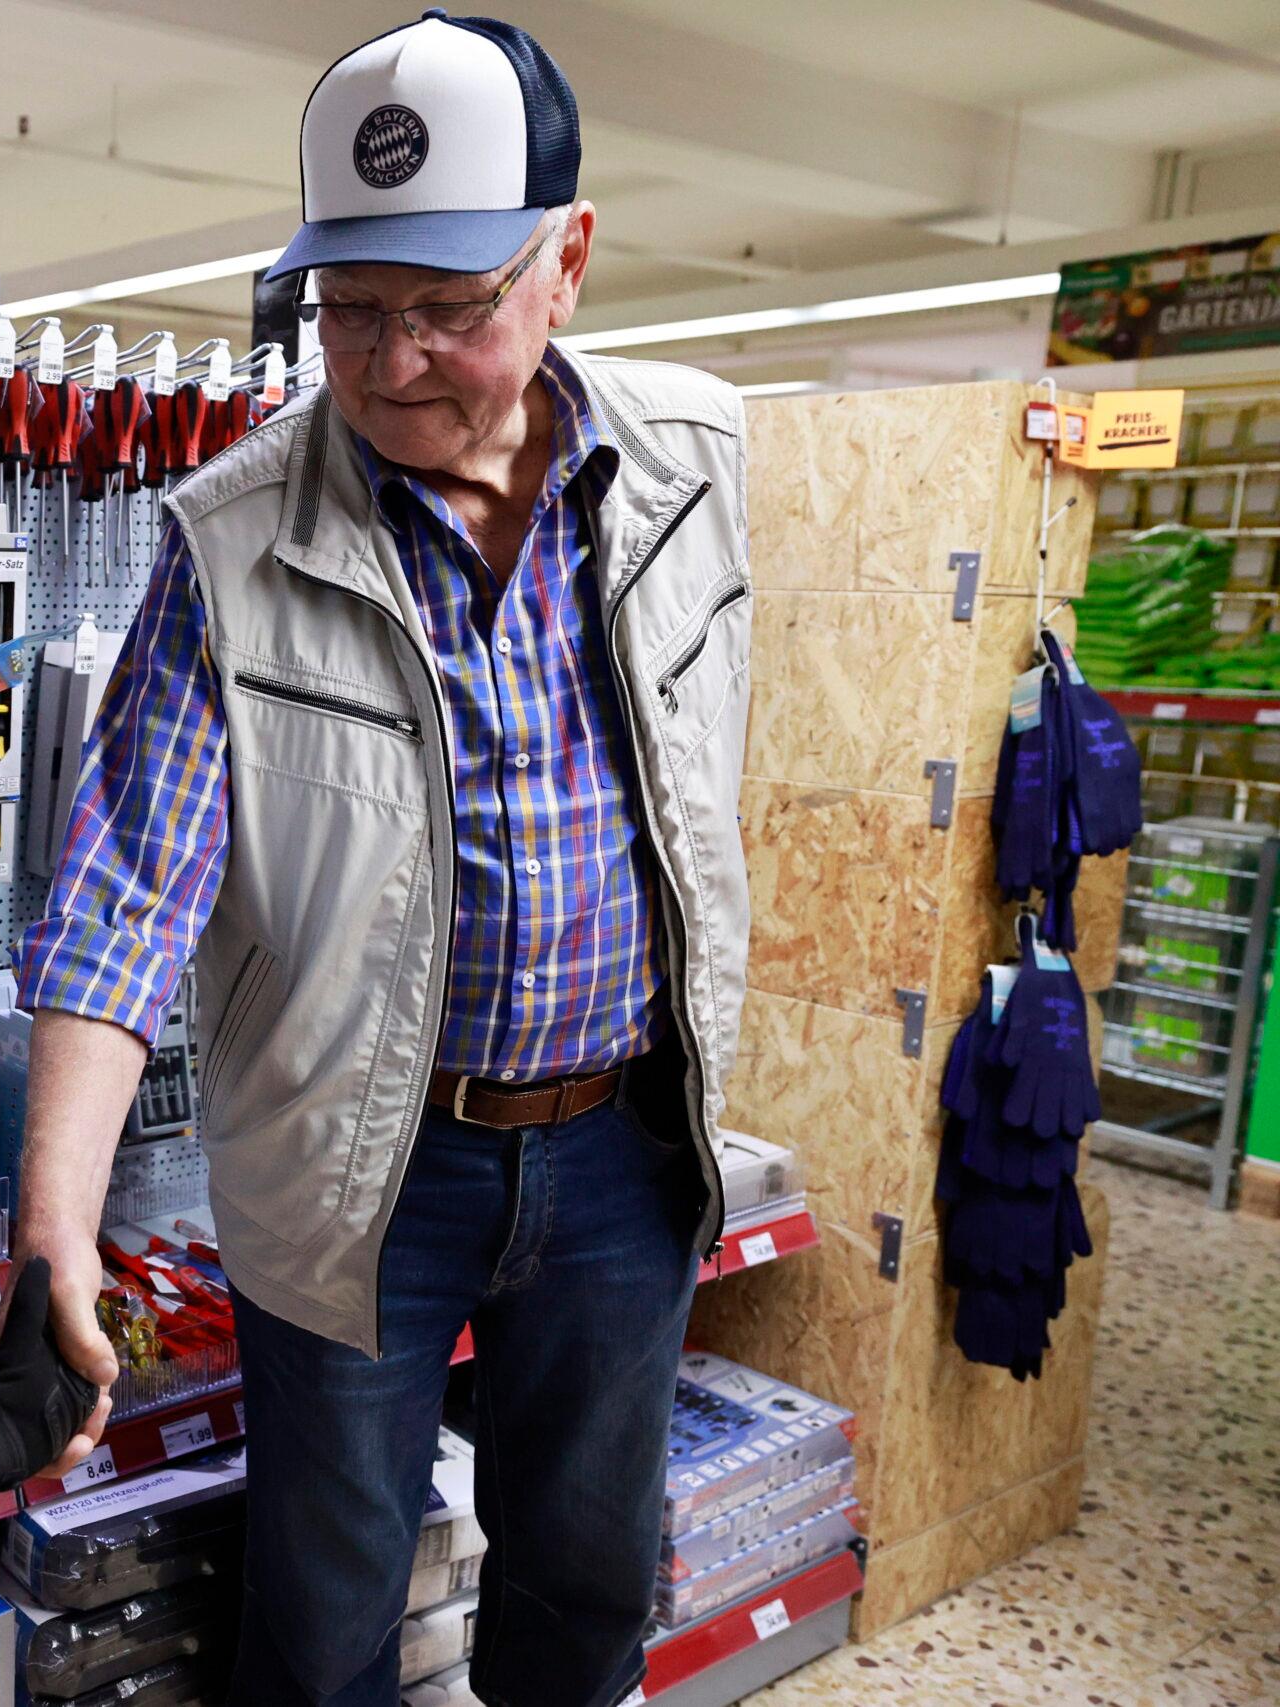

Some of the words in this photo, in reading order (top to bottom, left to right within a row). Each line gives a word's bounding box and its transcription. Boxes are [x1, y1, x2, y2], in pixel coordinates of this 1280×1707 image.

[361, 127, 373, 143] FC
[374, 111, 422, 139] BAYERN
[45, 371, 61, 381] 2,99
[100, 378, 114, 387] 2,99
[1115, 411, 1157, 425] PREIS-
[1103, 424, 1168, 439] KRACHER!
[16, 537, 27, 548] 5x
[188, 1427, 212, 1446] 1,99
[87, 1460, 114, 1479] 8,49
[45, 1498, 93, 1518] WZK120
[93, 1474, 176, 1504] Werkzeugkoffer
